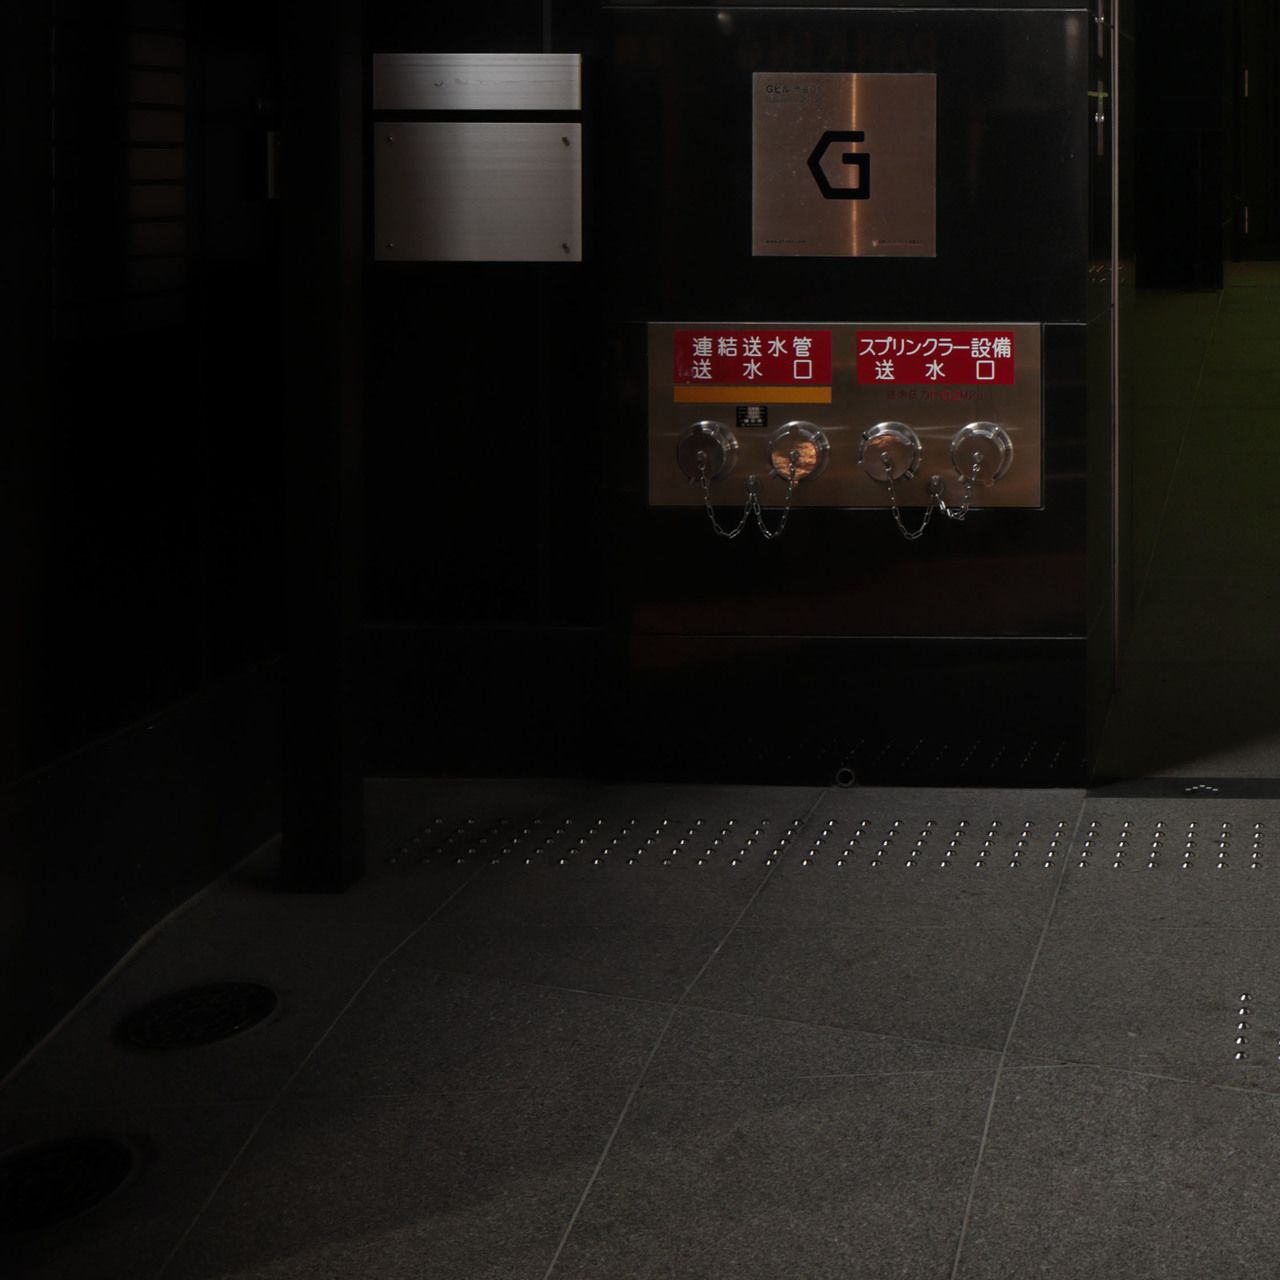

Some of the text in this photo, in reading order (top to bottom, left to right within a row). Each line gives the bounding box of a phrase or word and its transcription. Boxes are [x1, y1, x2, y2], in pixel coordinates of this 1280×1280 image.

[692, 335, 813, 358] 連結送水管
[858, 336, 1013, 359] スプリンクラー設備
